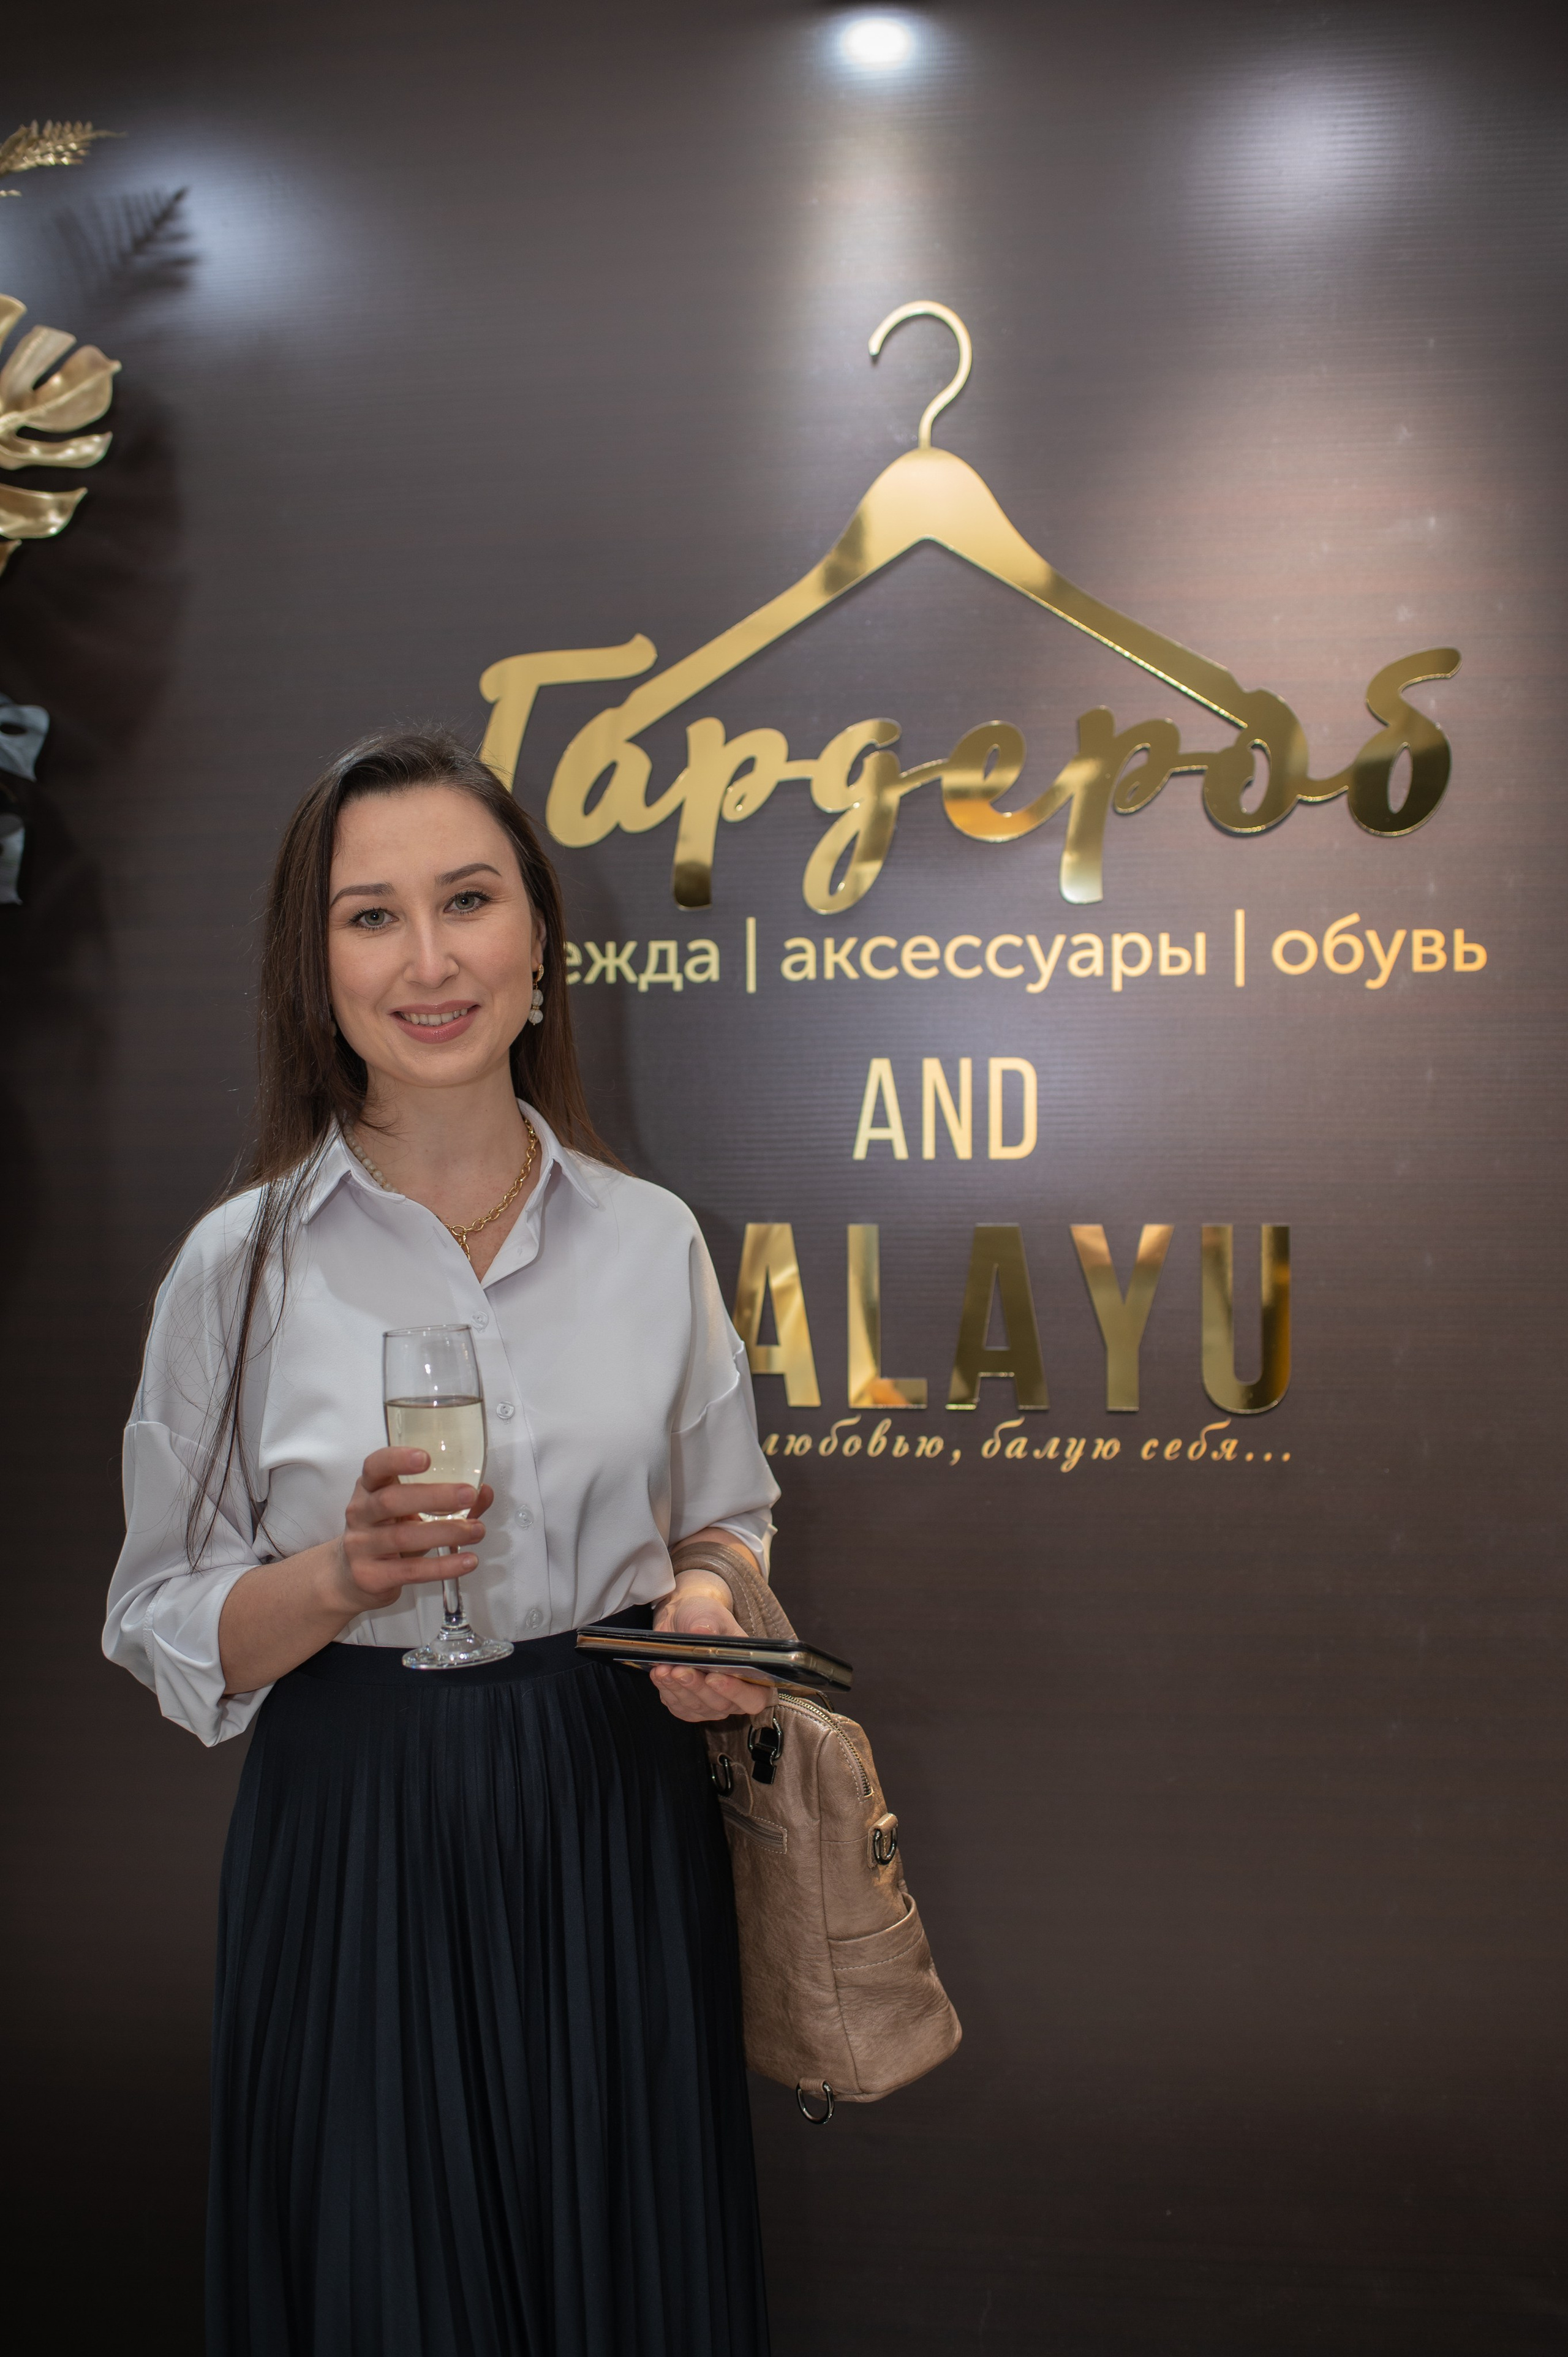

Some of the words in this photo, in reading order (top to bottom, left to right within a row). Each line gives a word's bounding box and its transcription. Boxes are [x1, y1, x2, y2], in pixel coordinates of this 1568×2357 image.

[480, 633, 1462, 915] Гардероб
[563, 938, 720, 992] ежда
[781, 932, 1206, 994] аксессуары
[1271, 913, 1488, 990] обувь
[853, 1057, 1038, 1160] AND
[733, 1223, 1291, 1414] ALAYU
[981, 1416, 1121, 1473] балую
